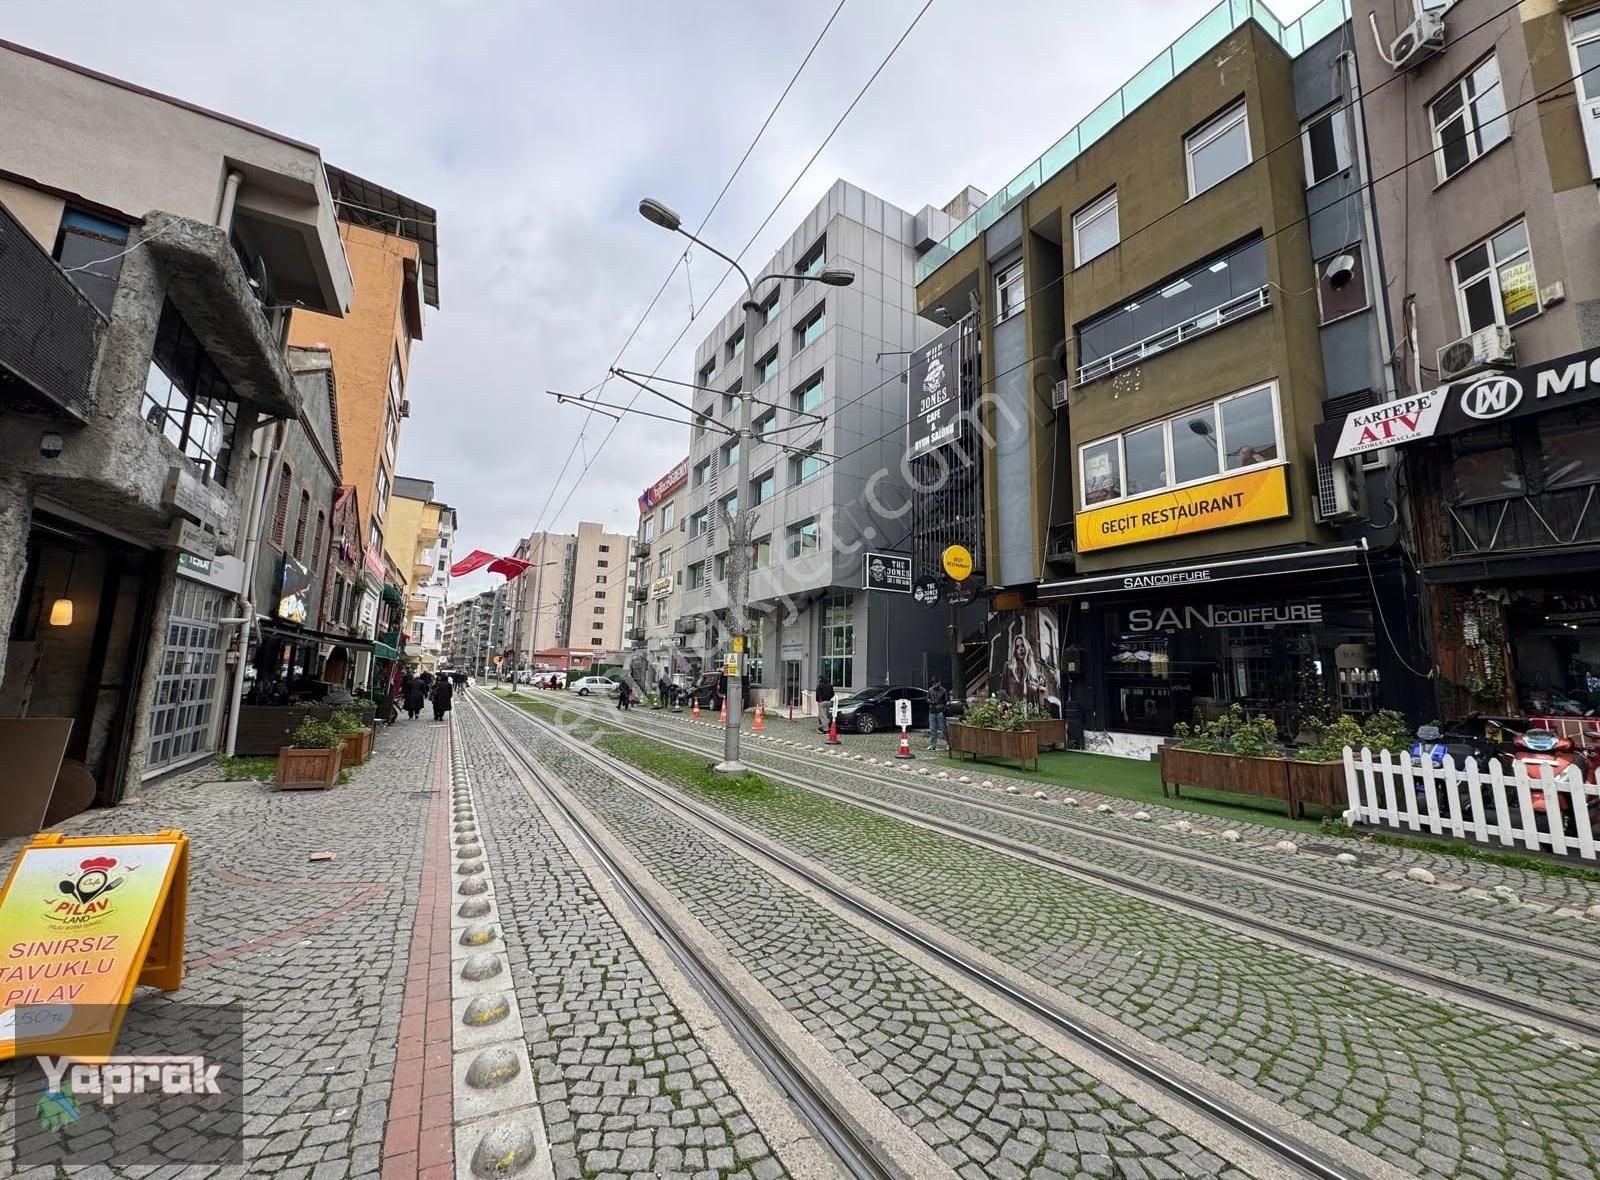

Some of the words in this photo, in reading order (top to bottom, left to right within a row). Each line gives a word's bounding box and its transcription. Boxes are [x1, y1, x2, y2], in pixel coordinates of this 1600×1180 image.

[1537, 357, 1600, 398] M
[921, 387, 947, 411] JONES
[927, 409, 941, 424] CAFE
[1353, 396, 1432, 427] KARTEPE
[1358, 409, 1422, 445] ATV
[1101, 514, 1138, 535] GEÇİT
[1142, 492, 1244, 526] RESTAURANT
[63, 915, 90, 924] LAND
[9, 935, 119, 958] SINIRSIZ
[4, 984, 84, 1006] PİLAV
